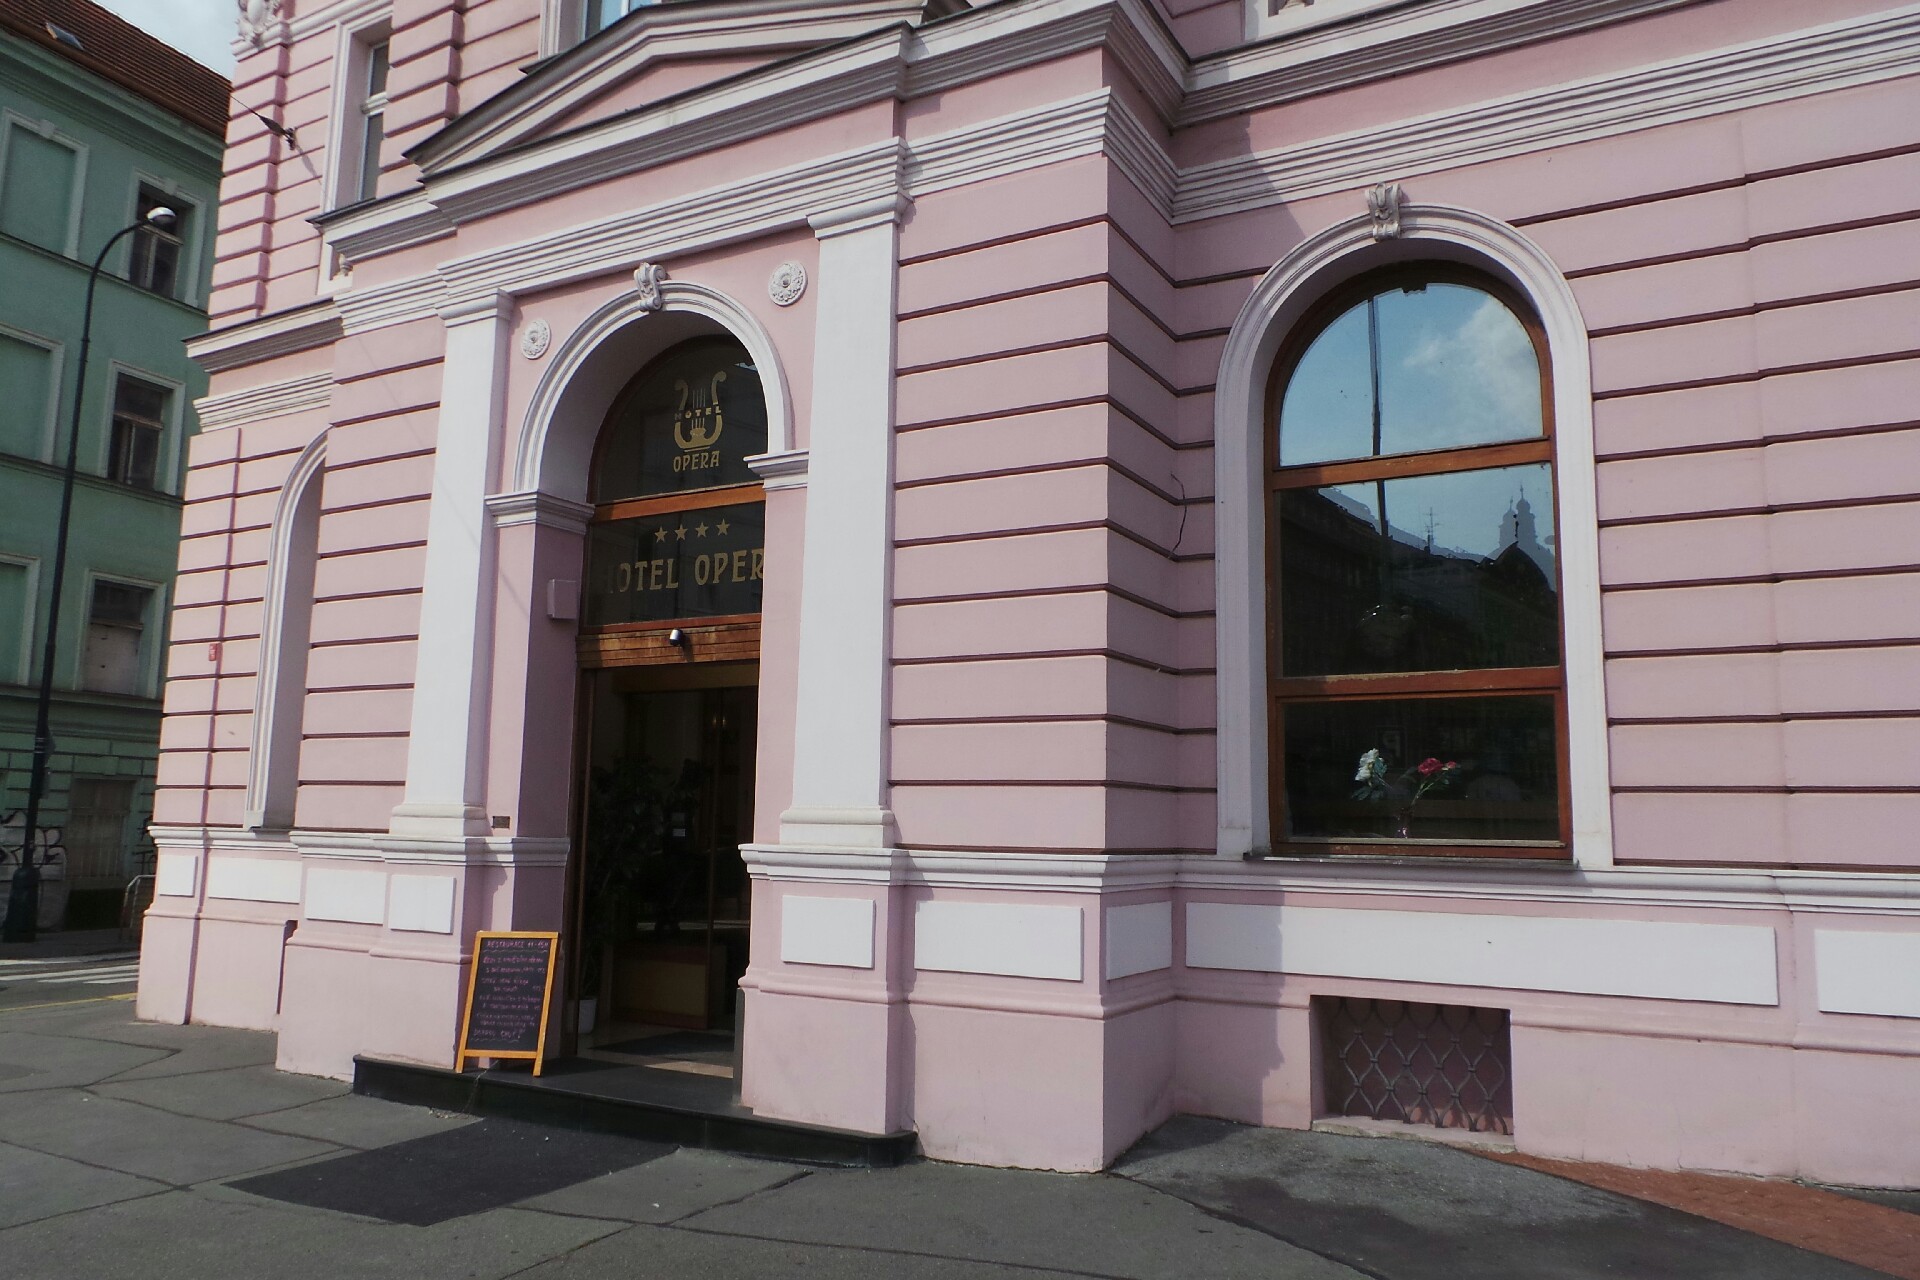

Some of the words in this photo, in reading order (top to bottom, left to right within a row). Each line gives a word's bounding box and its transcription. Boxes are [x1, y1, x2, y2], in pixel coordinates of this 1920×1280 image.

[674, 405, 722, 421] HOTEL
[673, 450, 720, 473] OPERA
[608, 558, 679, 594] OTEL
